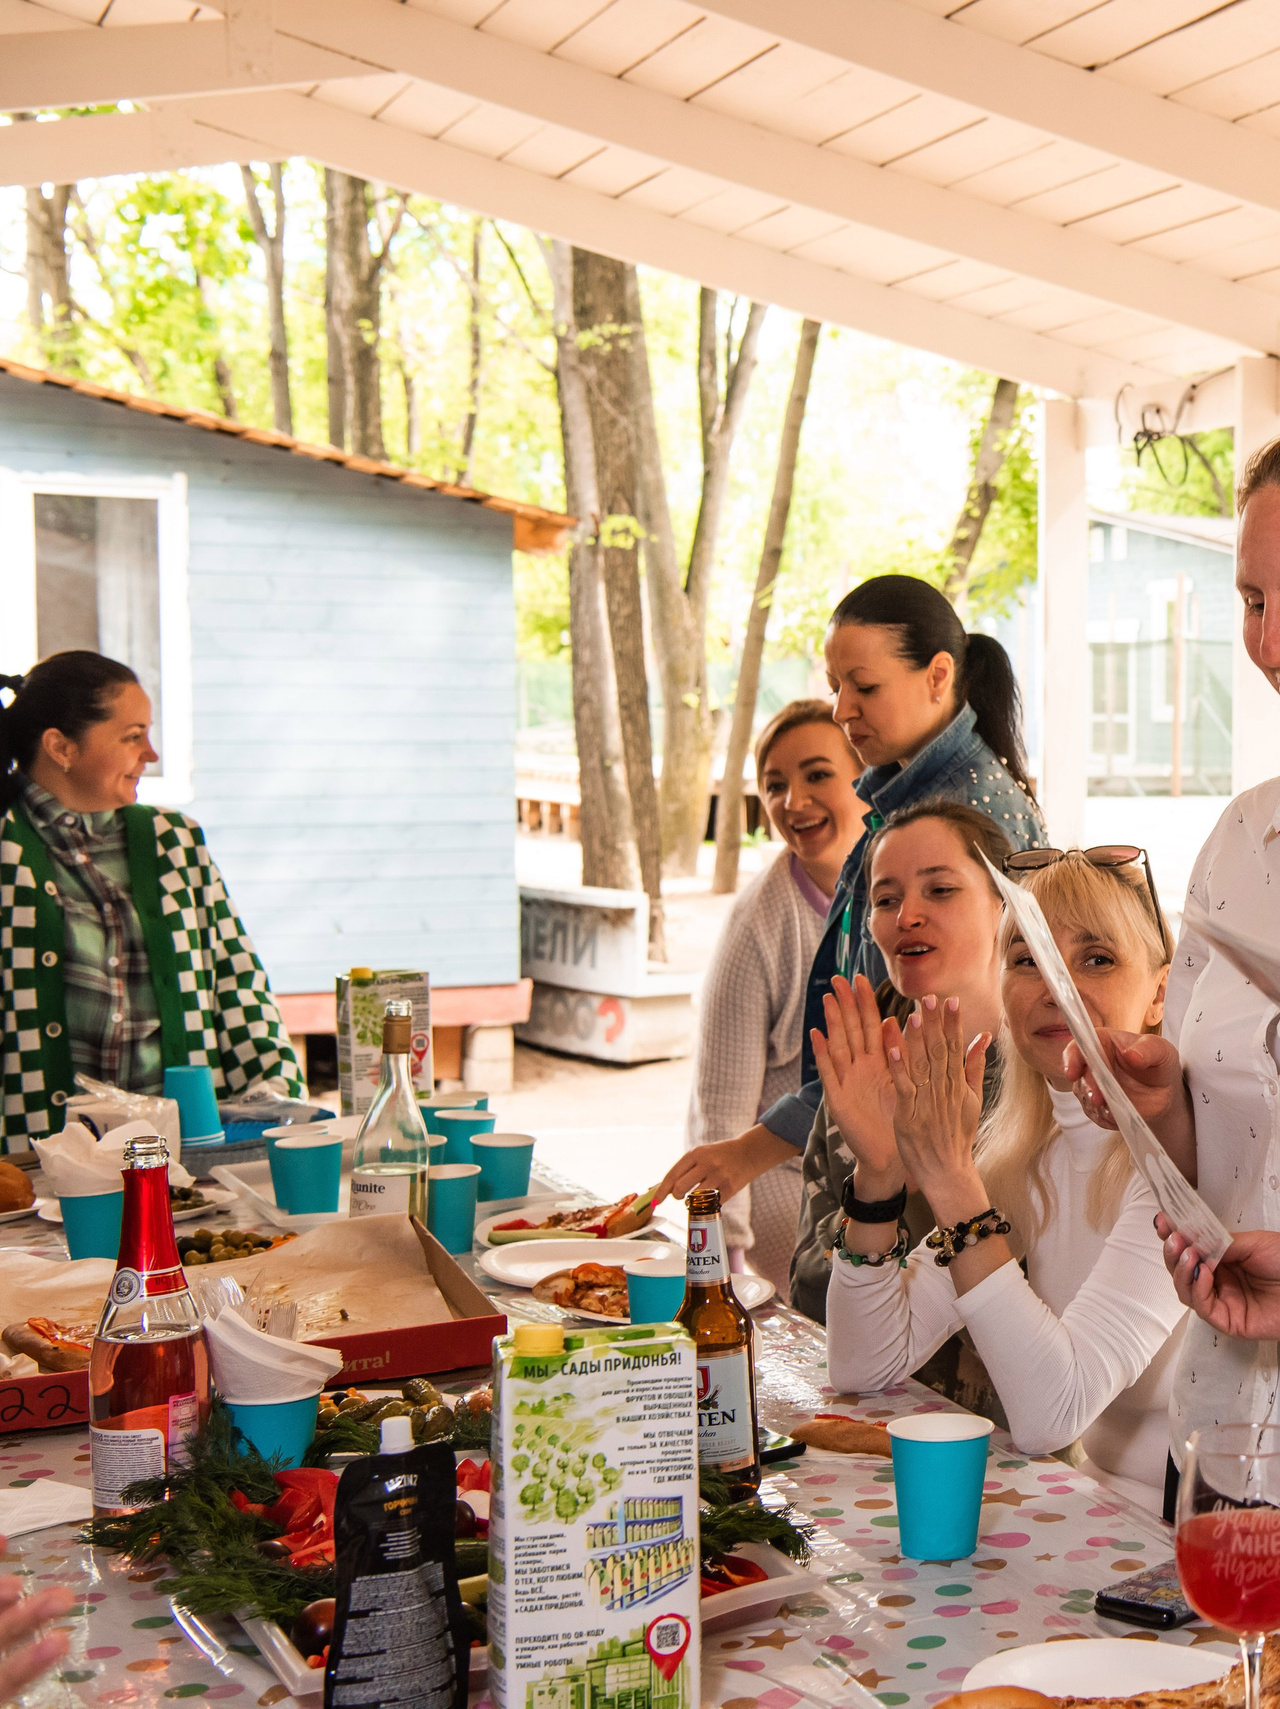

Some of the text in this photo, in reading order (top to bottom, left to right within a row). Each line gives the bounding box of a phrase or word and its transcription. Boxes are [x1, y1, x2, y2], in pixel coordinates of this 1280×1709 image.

[524, 1365, 548, 1378] МЫ
[561, 1361, 600, 1376] САДЫ
[604, 1352, 682, 1372] ПРИДОНЬЯ!
[626, 1394, 656, 1403] ФРУКТОВ
[643, 1402, 692, 1411] ВЫРАЩЕННЫХ
[622, 1414, 646, 1422] НАШИХ
[658, 1429, 693, 1438] ОТВЕЧАЕМ
[660, 1439, 693, 1447] КАЧЕСТВО
[529, 1564, 570, 1574] ЗАБОТИМСЯ
[521, 1577, 535, 1585] ТЕХ,
[537, 1575, 554, 1583] КОГО
[520, 1604, 543, 1612] САДАХ
[516, 1633, 559, 1644] ПЕРЕХОДИТЕ
[516, 1661, 542, 1669] УМНЫЕ
